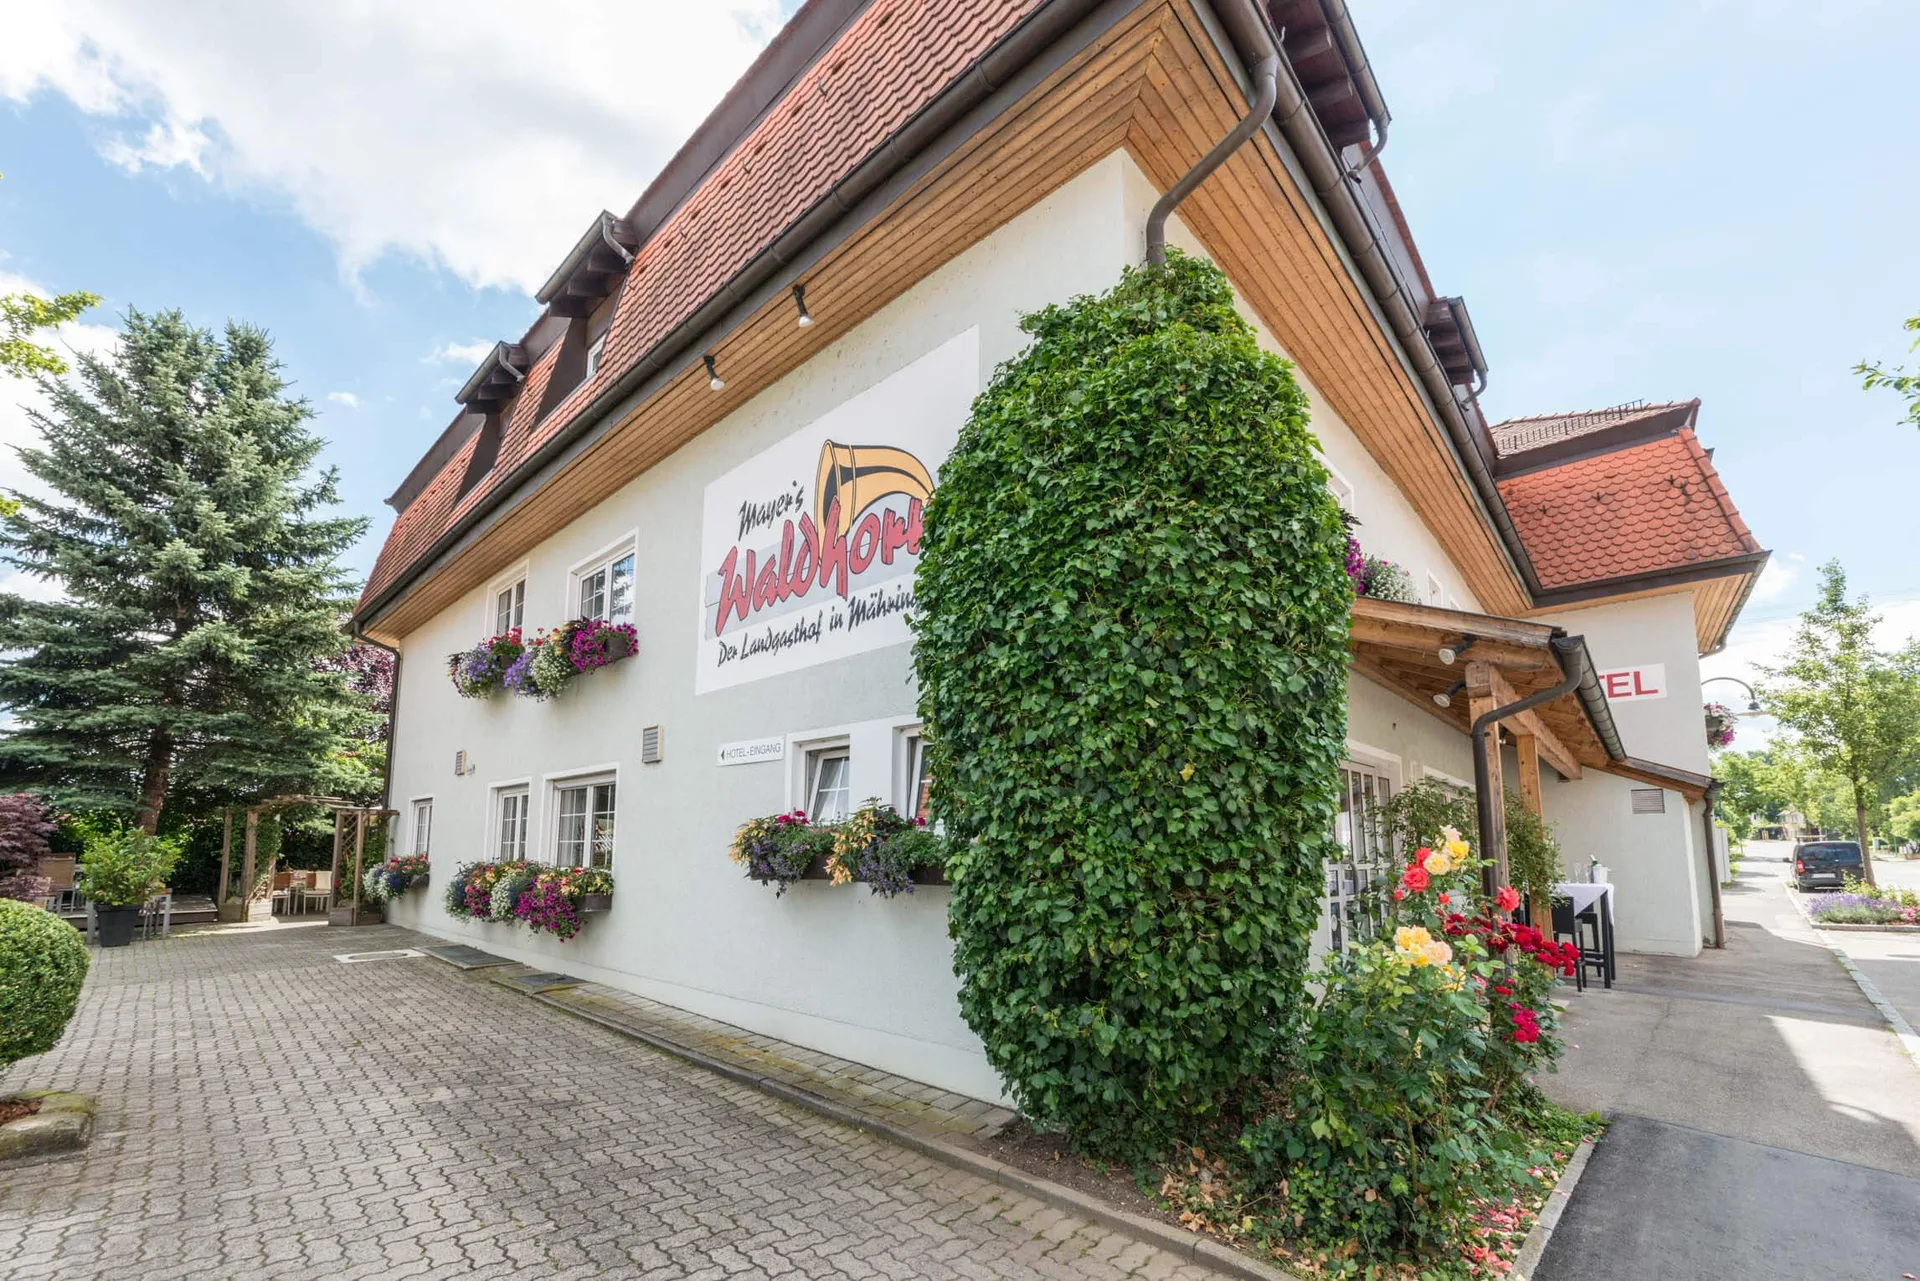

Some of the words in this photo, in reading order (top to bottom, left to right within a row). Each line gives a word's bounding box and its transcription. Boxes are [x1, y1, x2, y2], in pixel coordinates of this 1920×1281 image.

[717, 640, 738, 667] Der
[740, 609, 823, 660] Landgasthof
[829, 605, 843, 632] in
[1599, 671, 1658, 698] EL
